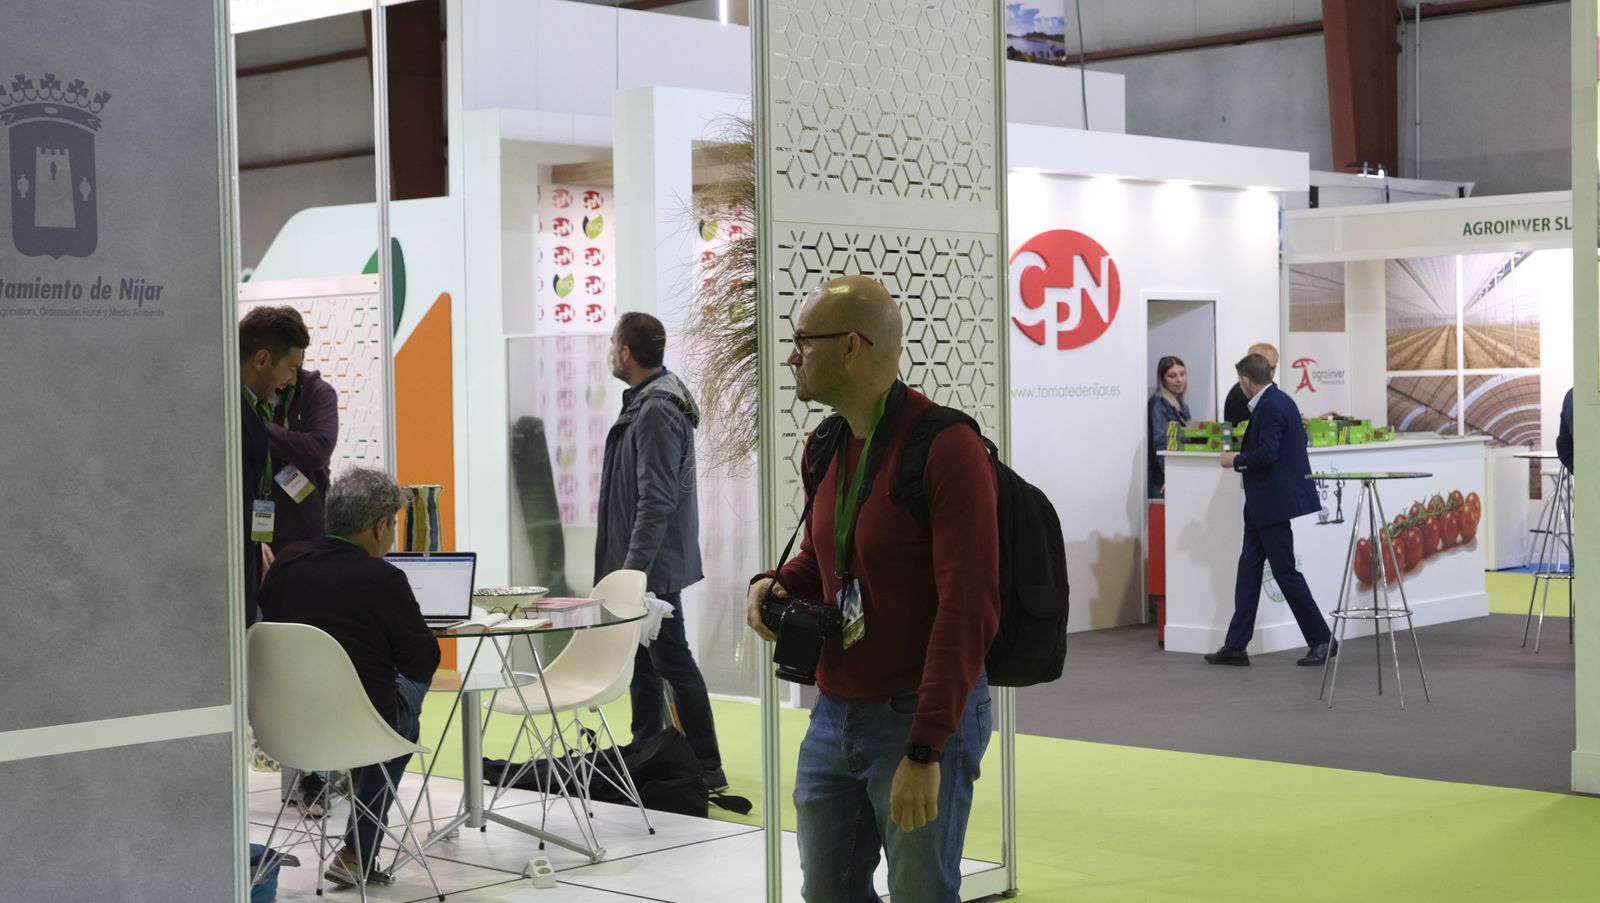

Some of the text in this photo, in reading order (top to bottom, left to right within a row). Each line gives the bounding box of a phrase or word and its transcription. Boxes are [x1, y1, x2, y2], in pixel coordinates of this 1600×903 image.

[1463, 216, 1573, 236] AGROINVER SL
[90, 275, 112, 300] de
[119, 278, 164, 307] Níjar
[1009, 250, 1110, 350] CPN
